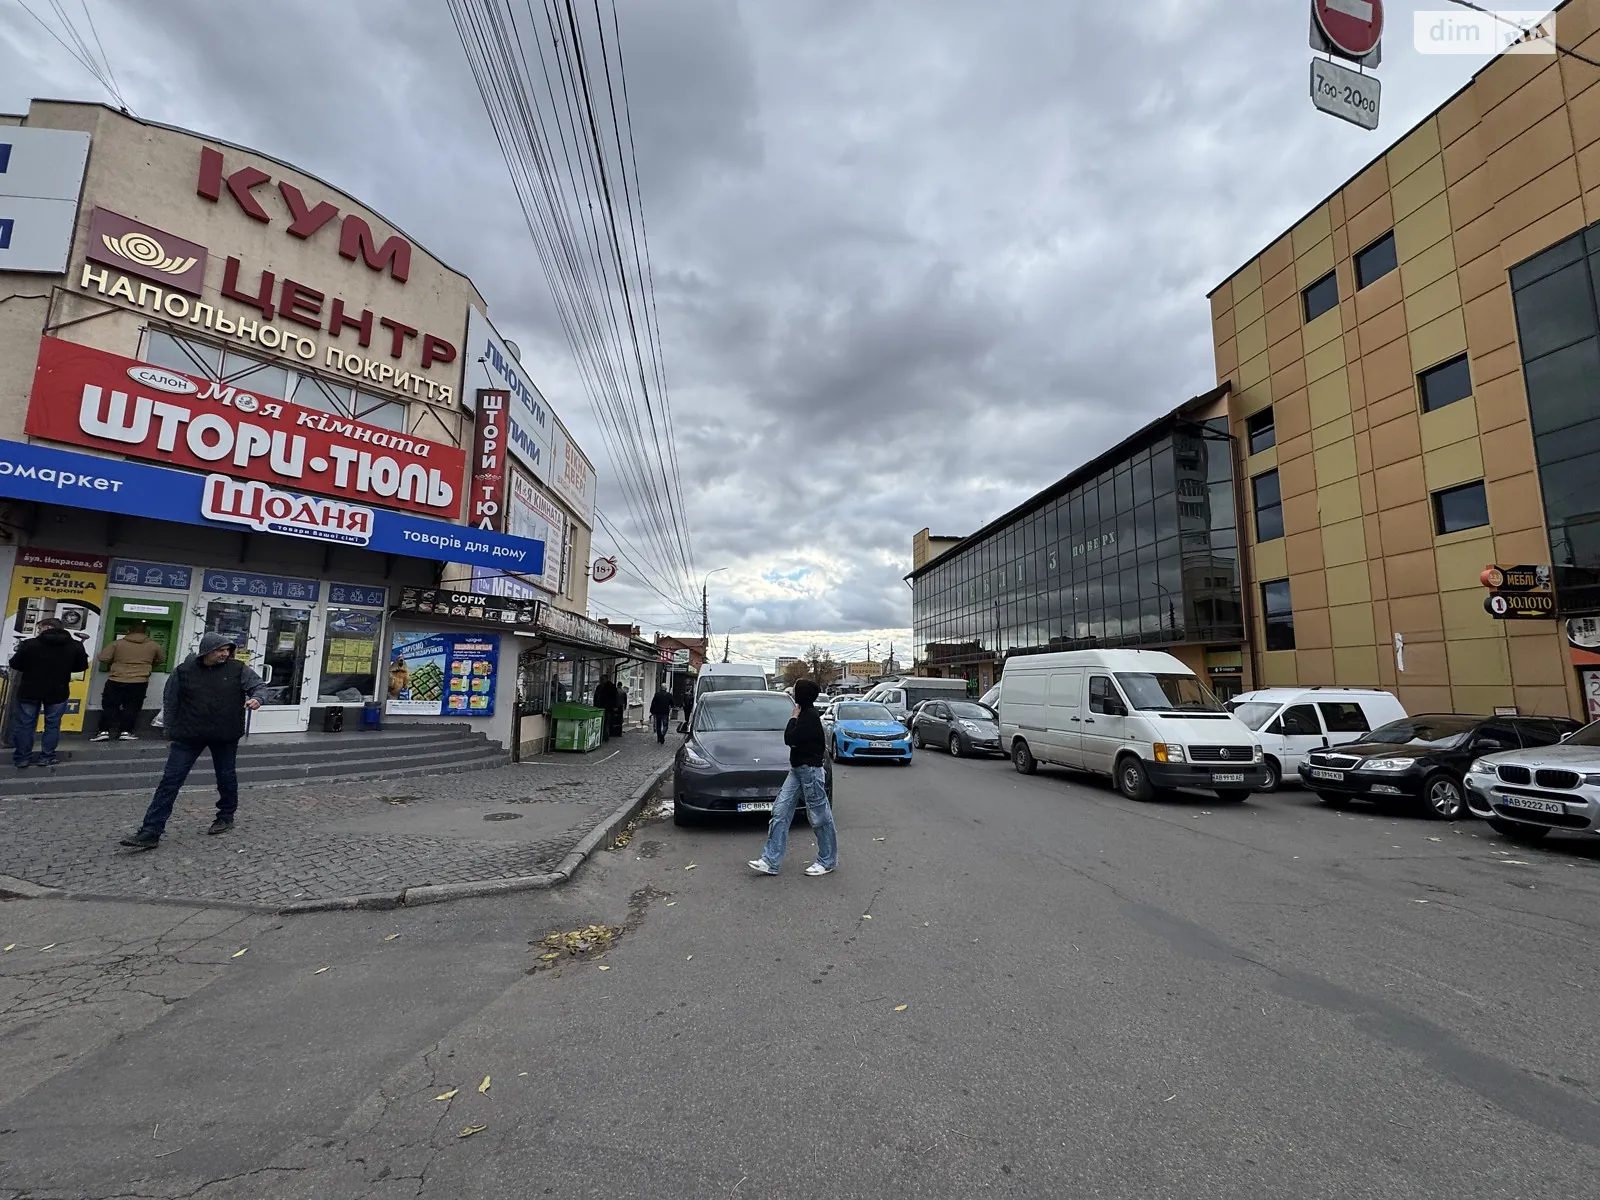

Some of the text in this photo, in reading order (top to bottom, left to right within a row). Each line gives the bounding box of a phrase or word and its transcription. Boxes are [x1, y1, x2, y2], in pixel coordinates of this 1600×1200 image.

[197, 145, 412, 283] КУМ
[221, 255, 457, 370] ЦЕНТР
[80, 263, 454, 406] НАПОЛЬНОГО ПОКРИТТЯ
[139, 370, 188, 391] САЛОН
[485, 338, 546, 429] ЛІНОЛЕУМ
[297, 409, 431, 458] кімната
[481, 395, 503, 469] ШТОРИ
[533, 493, 561, 524] КІМНАТА
[403, 530, 527, 562] товарів для дому
[596, 565, 611, 573] 18+
[1049, 551, 1057, 570] 3
[21, 575, 97, 590] ТЕХНІКА
[43, 586, 84, 595] Європи
[1507, 574, 1534, 586] МЕБЛІ
[451, 594, 486, 606] COFIX
[1507, 596, 1552, 609] ЗОЛОТО
[1508, 797, 1521, 806] AB
[1521, 800, 1544, 810] 9222
